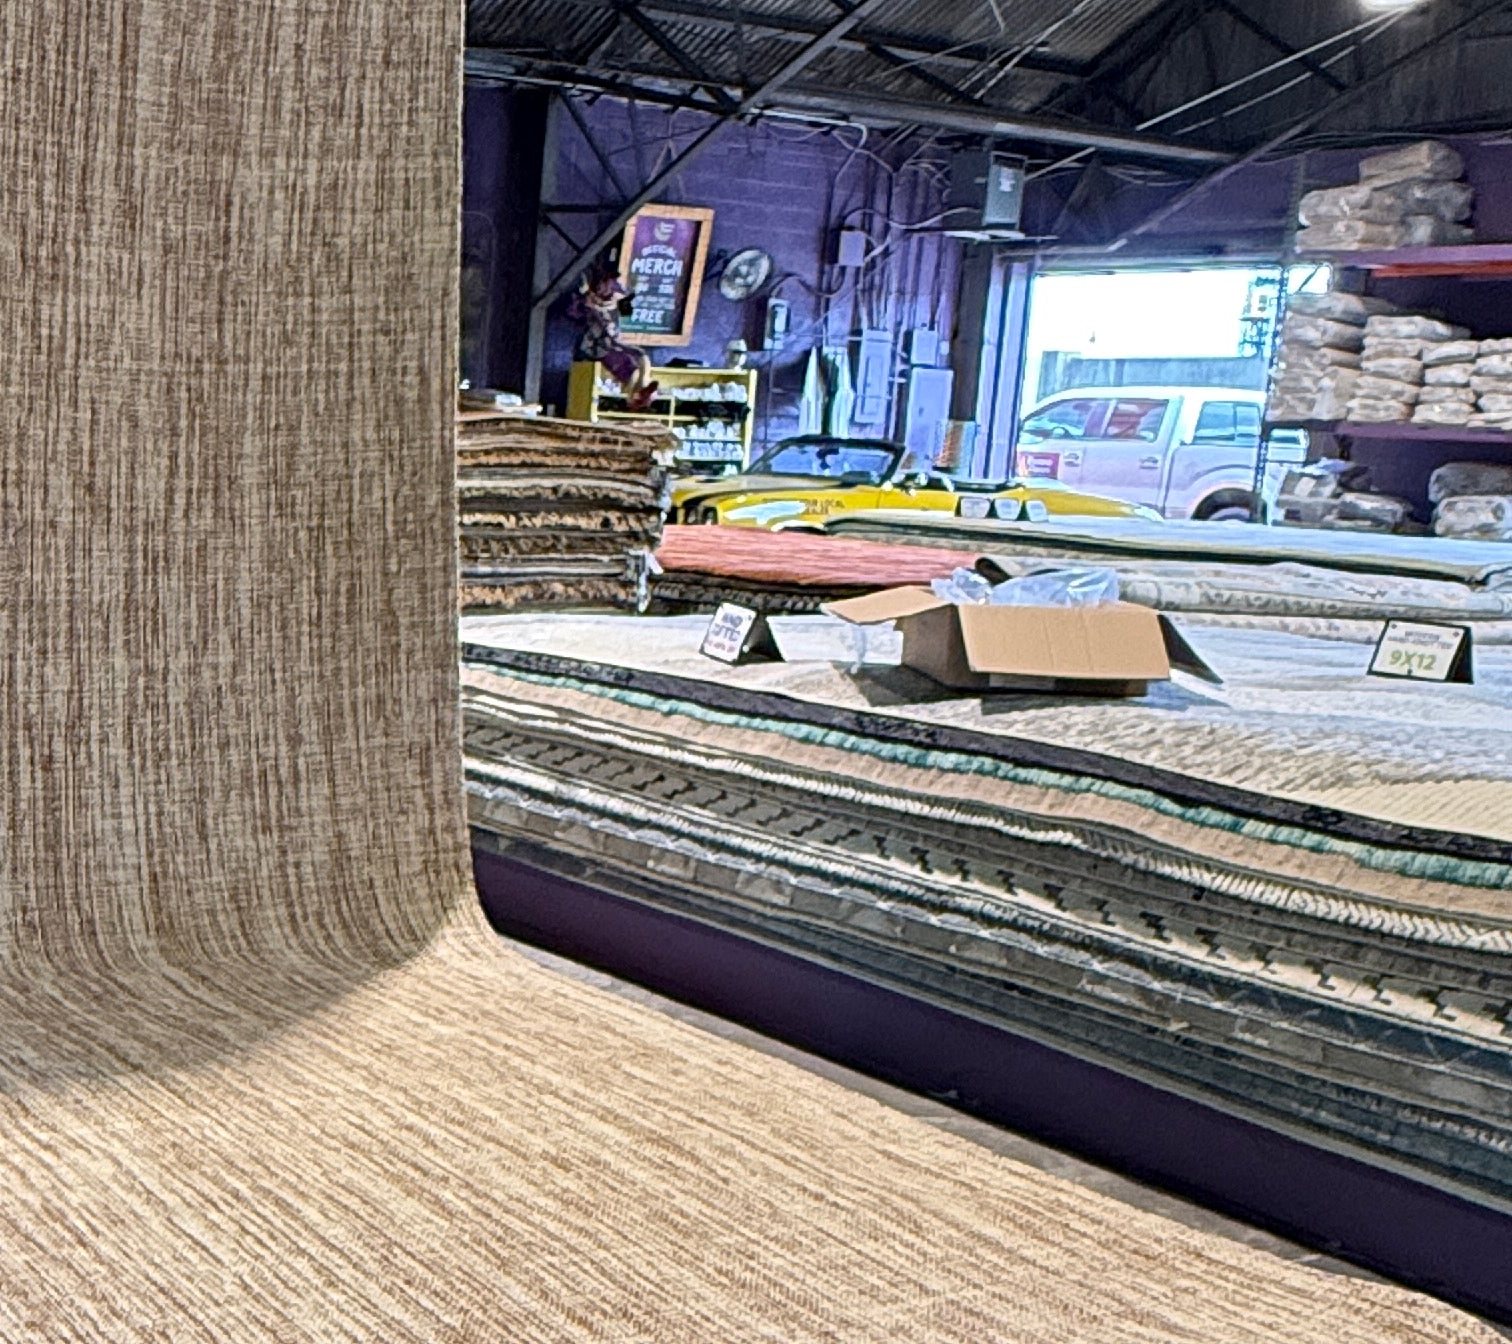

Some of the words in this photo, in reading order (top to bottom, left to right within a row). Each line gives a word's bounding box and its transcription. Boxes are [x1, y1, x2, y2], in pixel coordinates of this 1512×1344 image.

[631, 258, 684, 277] MERCH
[630, 308, 665, 324] FREE
[1388, 649, 1437, 671] 9X12
